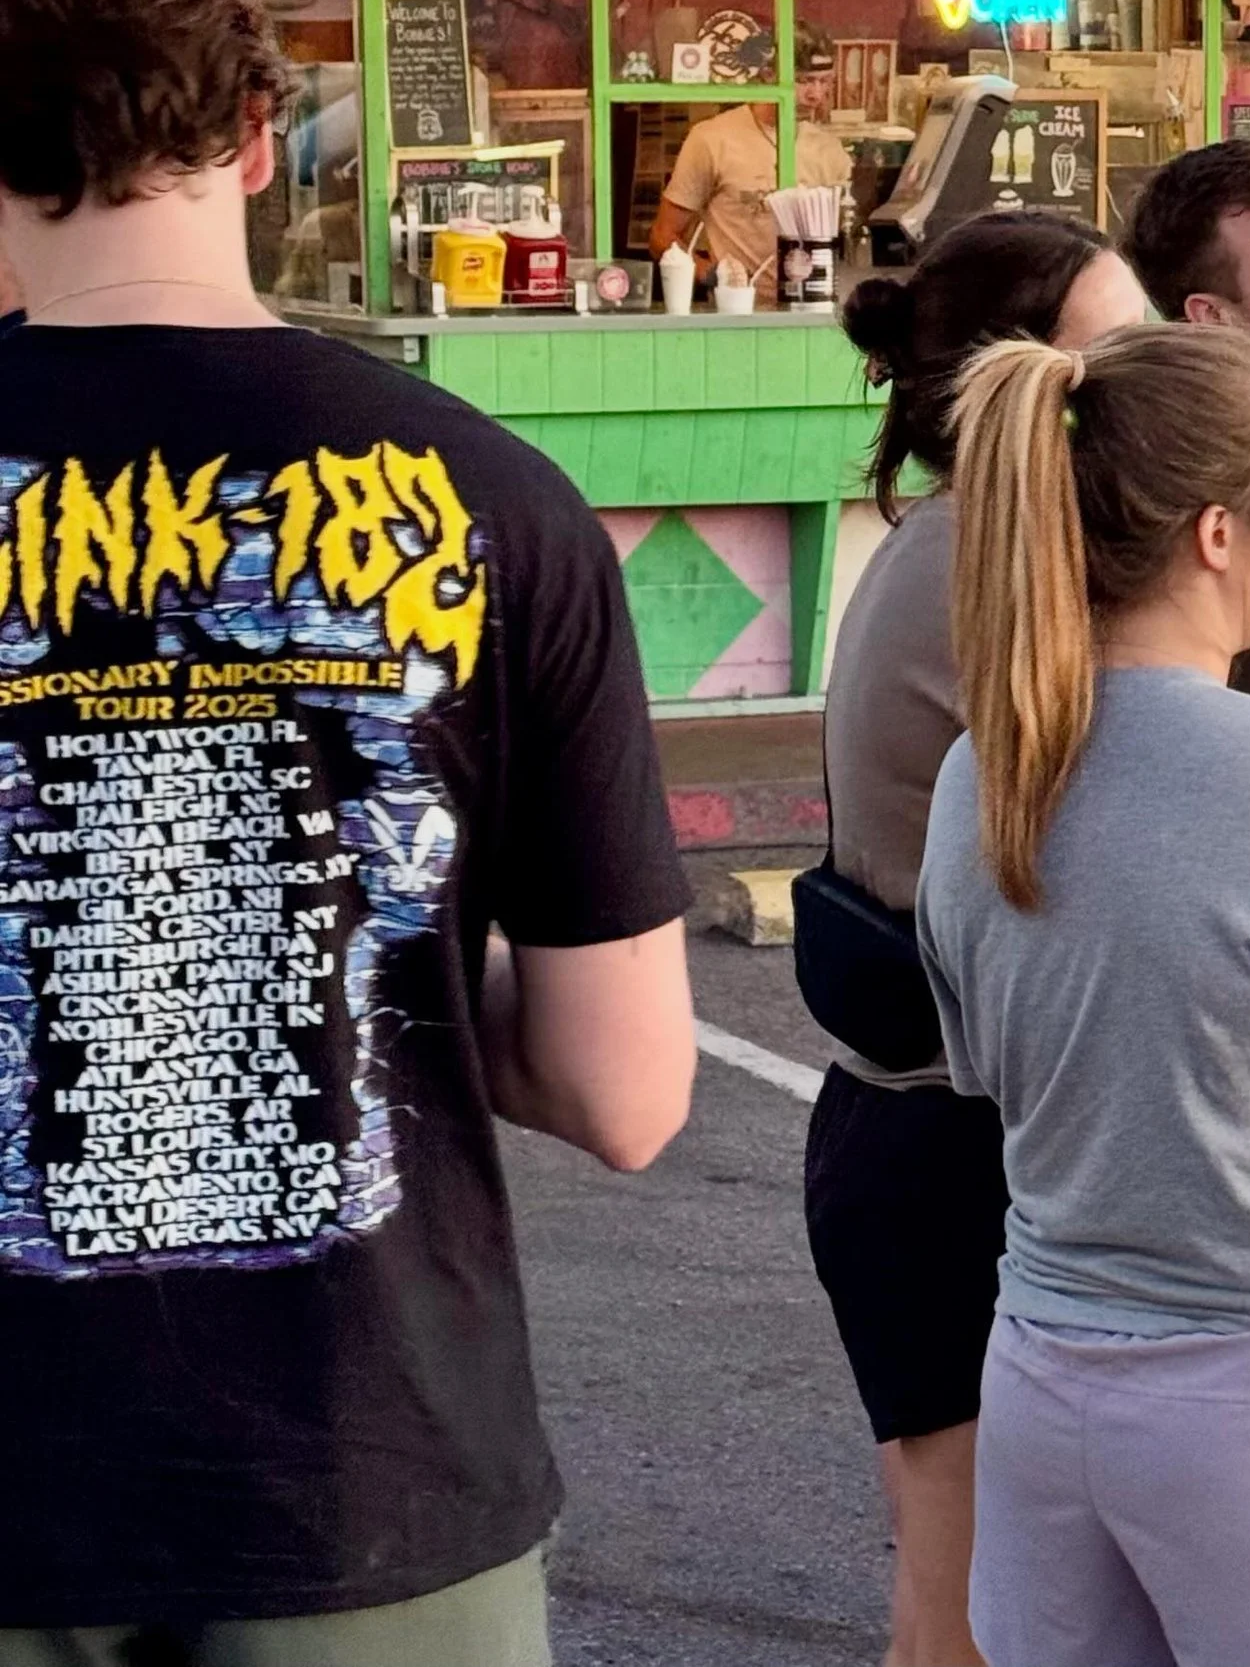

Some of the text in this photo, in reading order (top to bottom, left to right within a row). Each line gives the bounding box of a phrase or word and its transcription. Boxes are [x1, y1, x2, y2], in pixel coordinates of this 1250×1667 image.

[1054, 105, 1082, 122] ICE
[1038, 121, 1085, 138] CREAM
[0, 441, 487, 691] INK-182
[189, 659, 403, 689] IMPOSSIBLE
[72, 693, 280, 722] TOUR 2025
[271, 719, 308, 743] FL
[224, 745, 263, 769] FL
[270, 766, 312, 791] SC
[239, 792, 281, 815] NC
[13, 825, 166, 855] VIRGINIA
[298, 810, 334, 836] VA
[230, 840, 273, 863] NY
[325, 853, 360, 880] NY
[241, 887, 283, 911] NH
[30, 921, 151, 948] DARIEN
[294, 905, 338, 932] NY
[270, 932, 317, 957] PA
[42, 964, 179, 995] ASBURY
[286, 953, 334, 979] NJ
[262, 979, 311, 1004] OH
[287, 1003, 325, 1027] IN
[256, 1028, 288, 1051] IL
[248, 1050, 300, 1074] GA
[273, 1074, 321, 1097] AL
[240, 1098, 293, 1122] AR
[81, 1136, 126, 1160] ST.
[244, 1121, 298, 1146] MO
[46, 1152, 190, 1184] KANSAS
[279, 1141, 336, 1167] MO
[289, 1163, 341, 1189] CA
[50, 1204, 146, 1232] PALM
[285, 1188, 338, 1213] CA
[66, 1231, 138, 1257] LAS
[272, 1212, 321, 1238] NV
